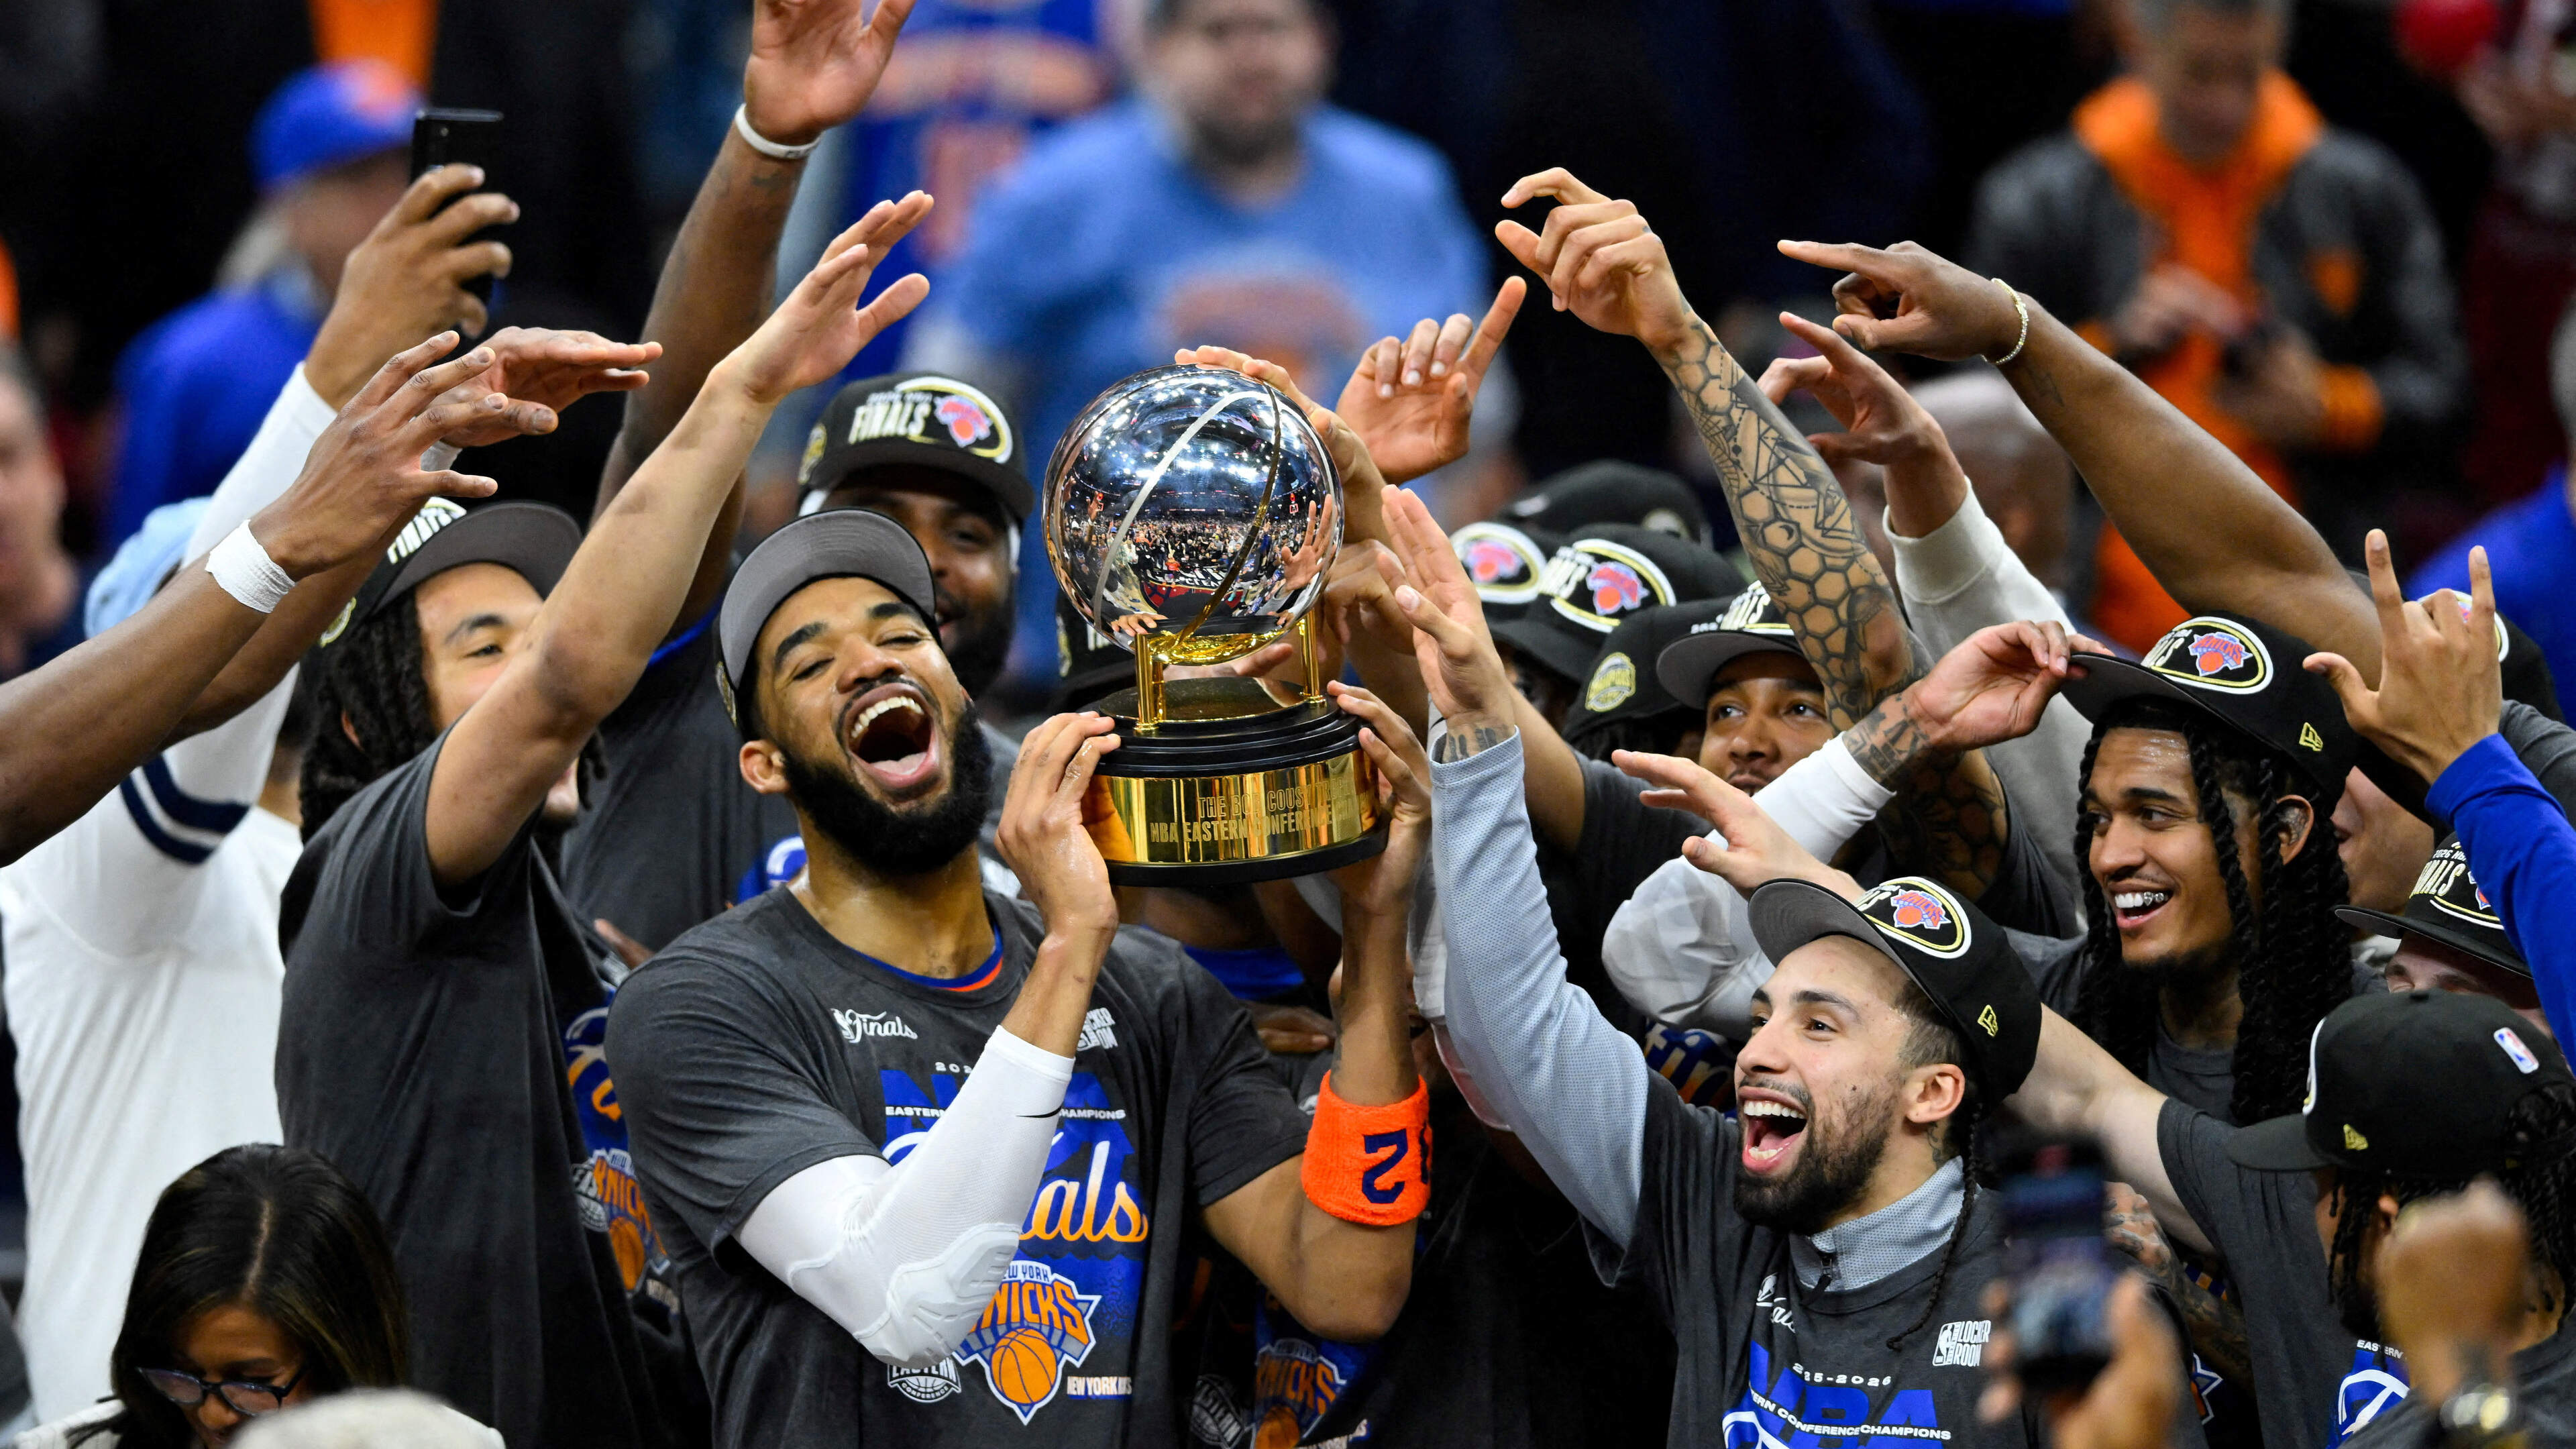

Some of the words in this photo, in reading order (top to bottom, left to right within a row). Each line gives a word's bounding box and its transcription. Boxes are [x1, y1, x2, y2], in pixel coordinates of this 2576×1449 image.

[2192, 635, 2243, 665] KNICKS
[1197, 796, 1226, 818] THE
[1150, 822, 1178, 843] NBA
[1183, 818, 1248, 842] EASTERN
[845, 1008, 918, 1044] Finals
[1022, 1265, 1050, 1283] YORK
[968, 1280, 1089, 1345] NICKS
[1957, 1320, 1992, 1344] LOCKER
[2357, 1339, 2404, 1359] EASERN
[1086, 1376, 1118, 1395] YORK
[1777, 1408, 1860, 1436] CONFERENCE
[1860, 1425, 1951, 1441] CHAMPIONS
